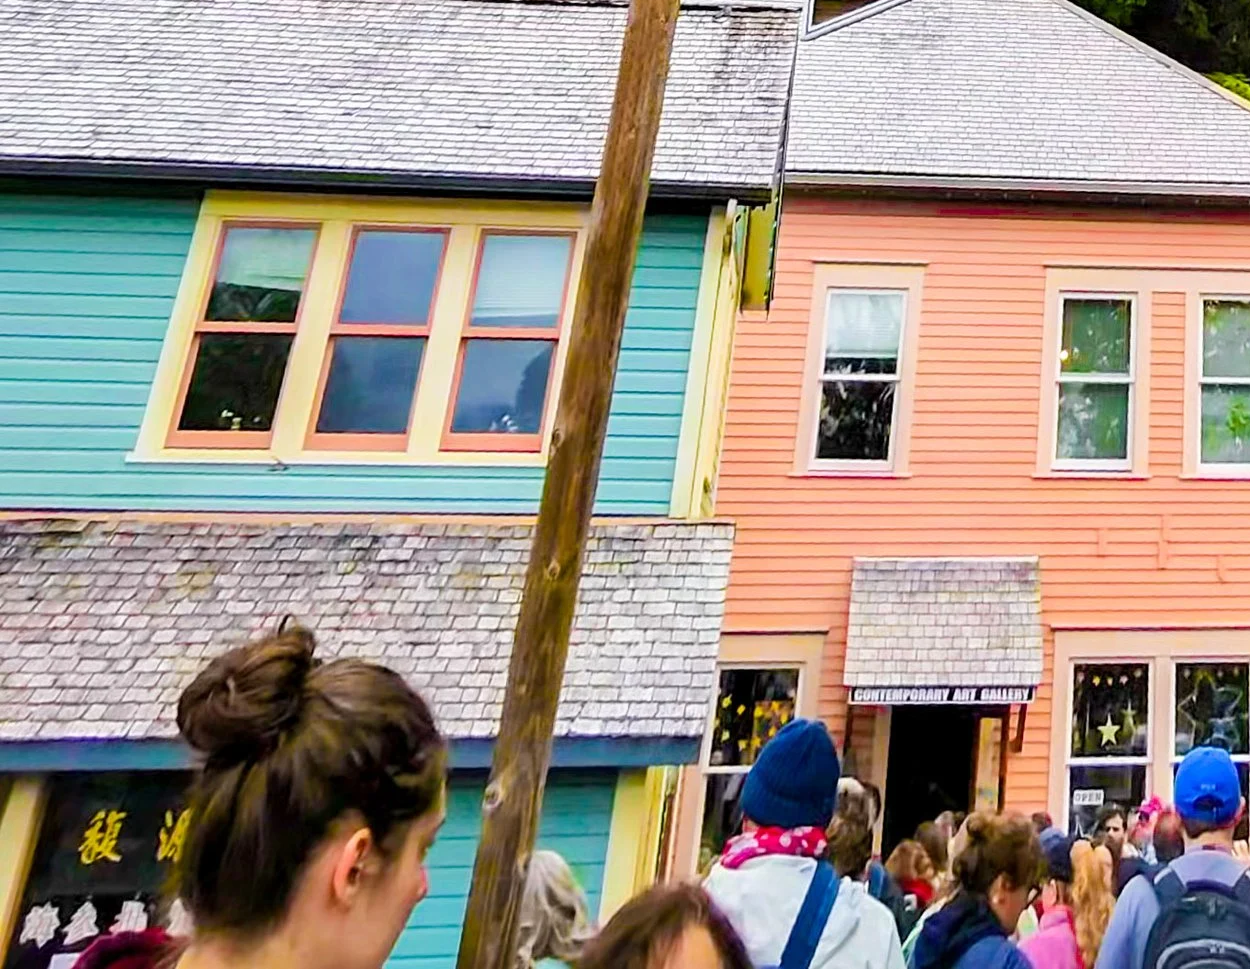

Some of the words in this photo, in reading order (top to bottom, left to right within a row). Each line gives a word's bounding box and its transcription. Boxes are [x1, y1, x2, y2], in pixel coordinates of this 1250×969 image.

[853, 687, 950, 702] CONTEMPORARY
[952, 687, 977, 701] ART
[980, 687, 1030, 701] GALLERY
[1074, 792, 1102, 802] OPEN
